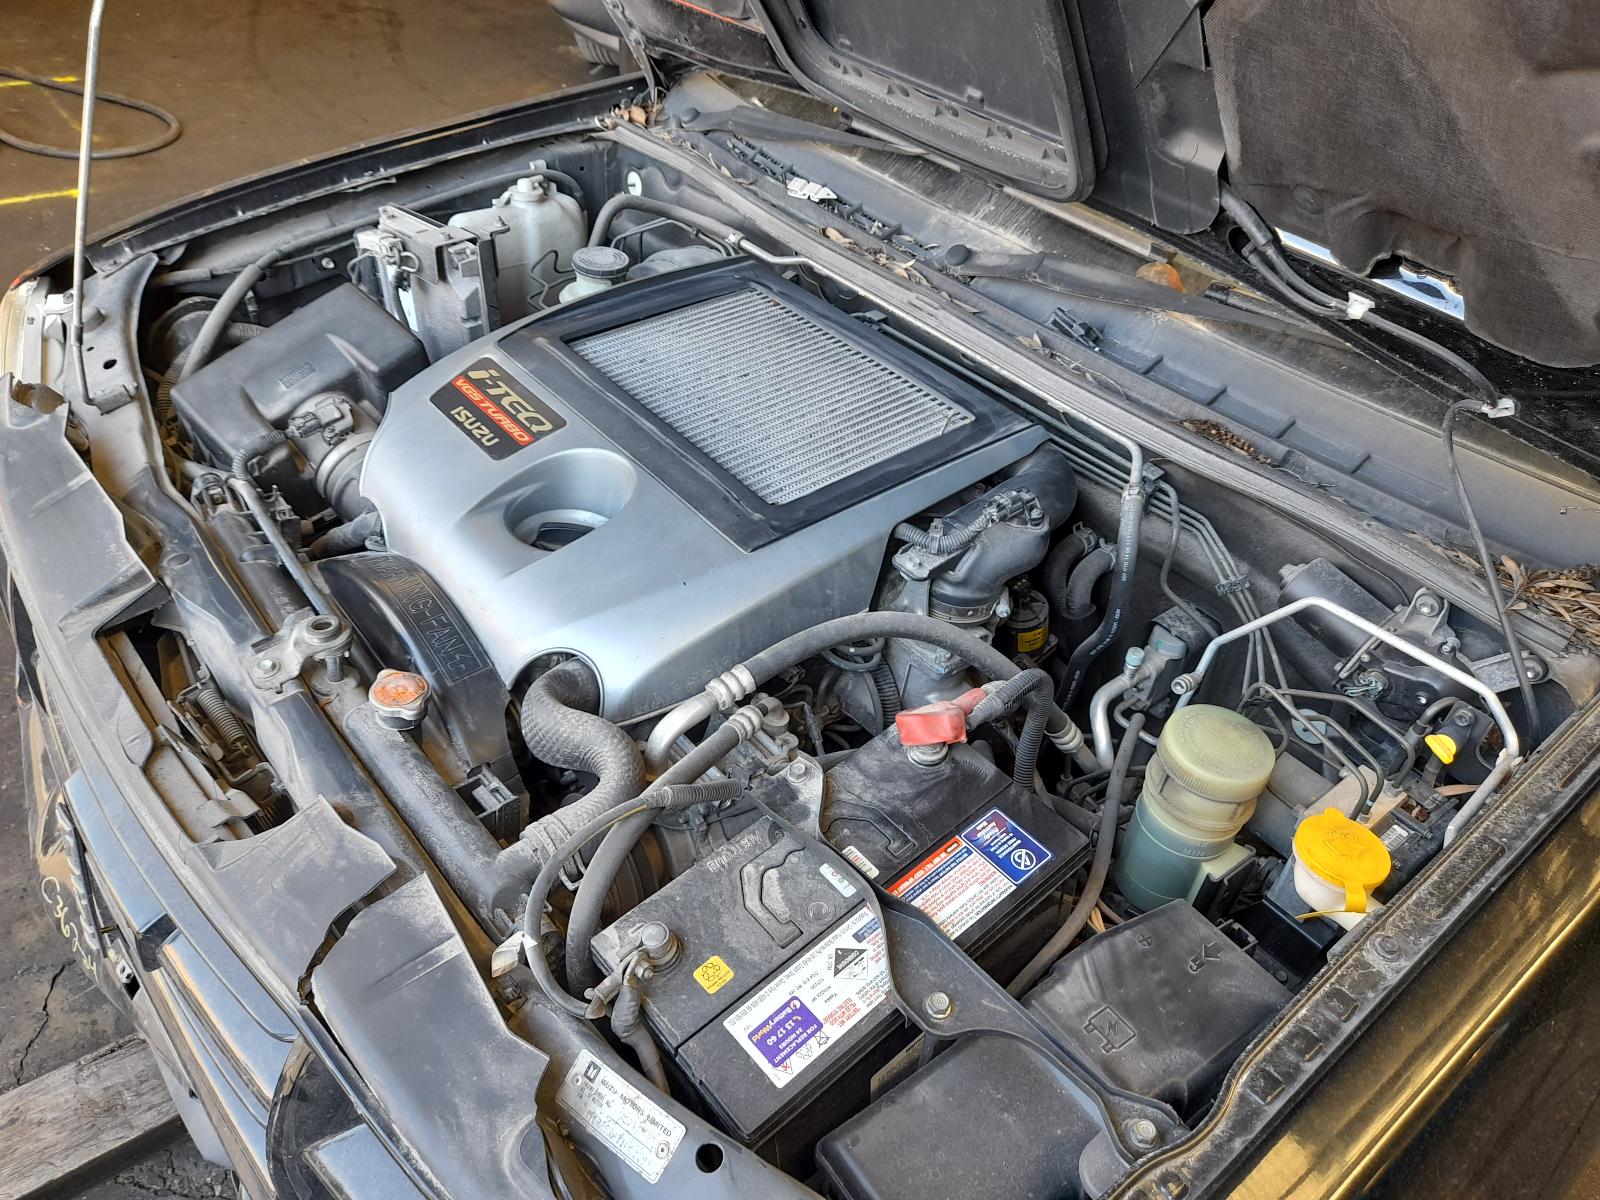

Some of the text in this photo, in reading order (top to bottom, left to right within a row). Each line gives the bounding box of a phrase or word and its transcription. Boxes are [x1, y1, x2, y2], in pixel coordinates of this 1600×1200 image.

[449, 406, 500, 447] ISUZU
[455, 378, 530, 442] VGS TURBO
[912, 868, 924, 879] KEEP
[931, 855, 941, 864] NOT
[749, 1004, 793, 1043] BatteryWorld
[765, 1019, 795, 1046] 13 17 60
[771, 1023, 817, 1063] FOR REPLACEMENT
[777, 1026, 803, 1049] 24 HOURS
[600, 1078, 618, 1095] ISUZU
[618, 1092, 645, 1116] MOTORS
[645, 1114, 672, 1138] LIMITED
